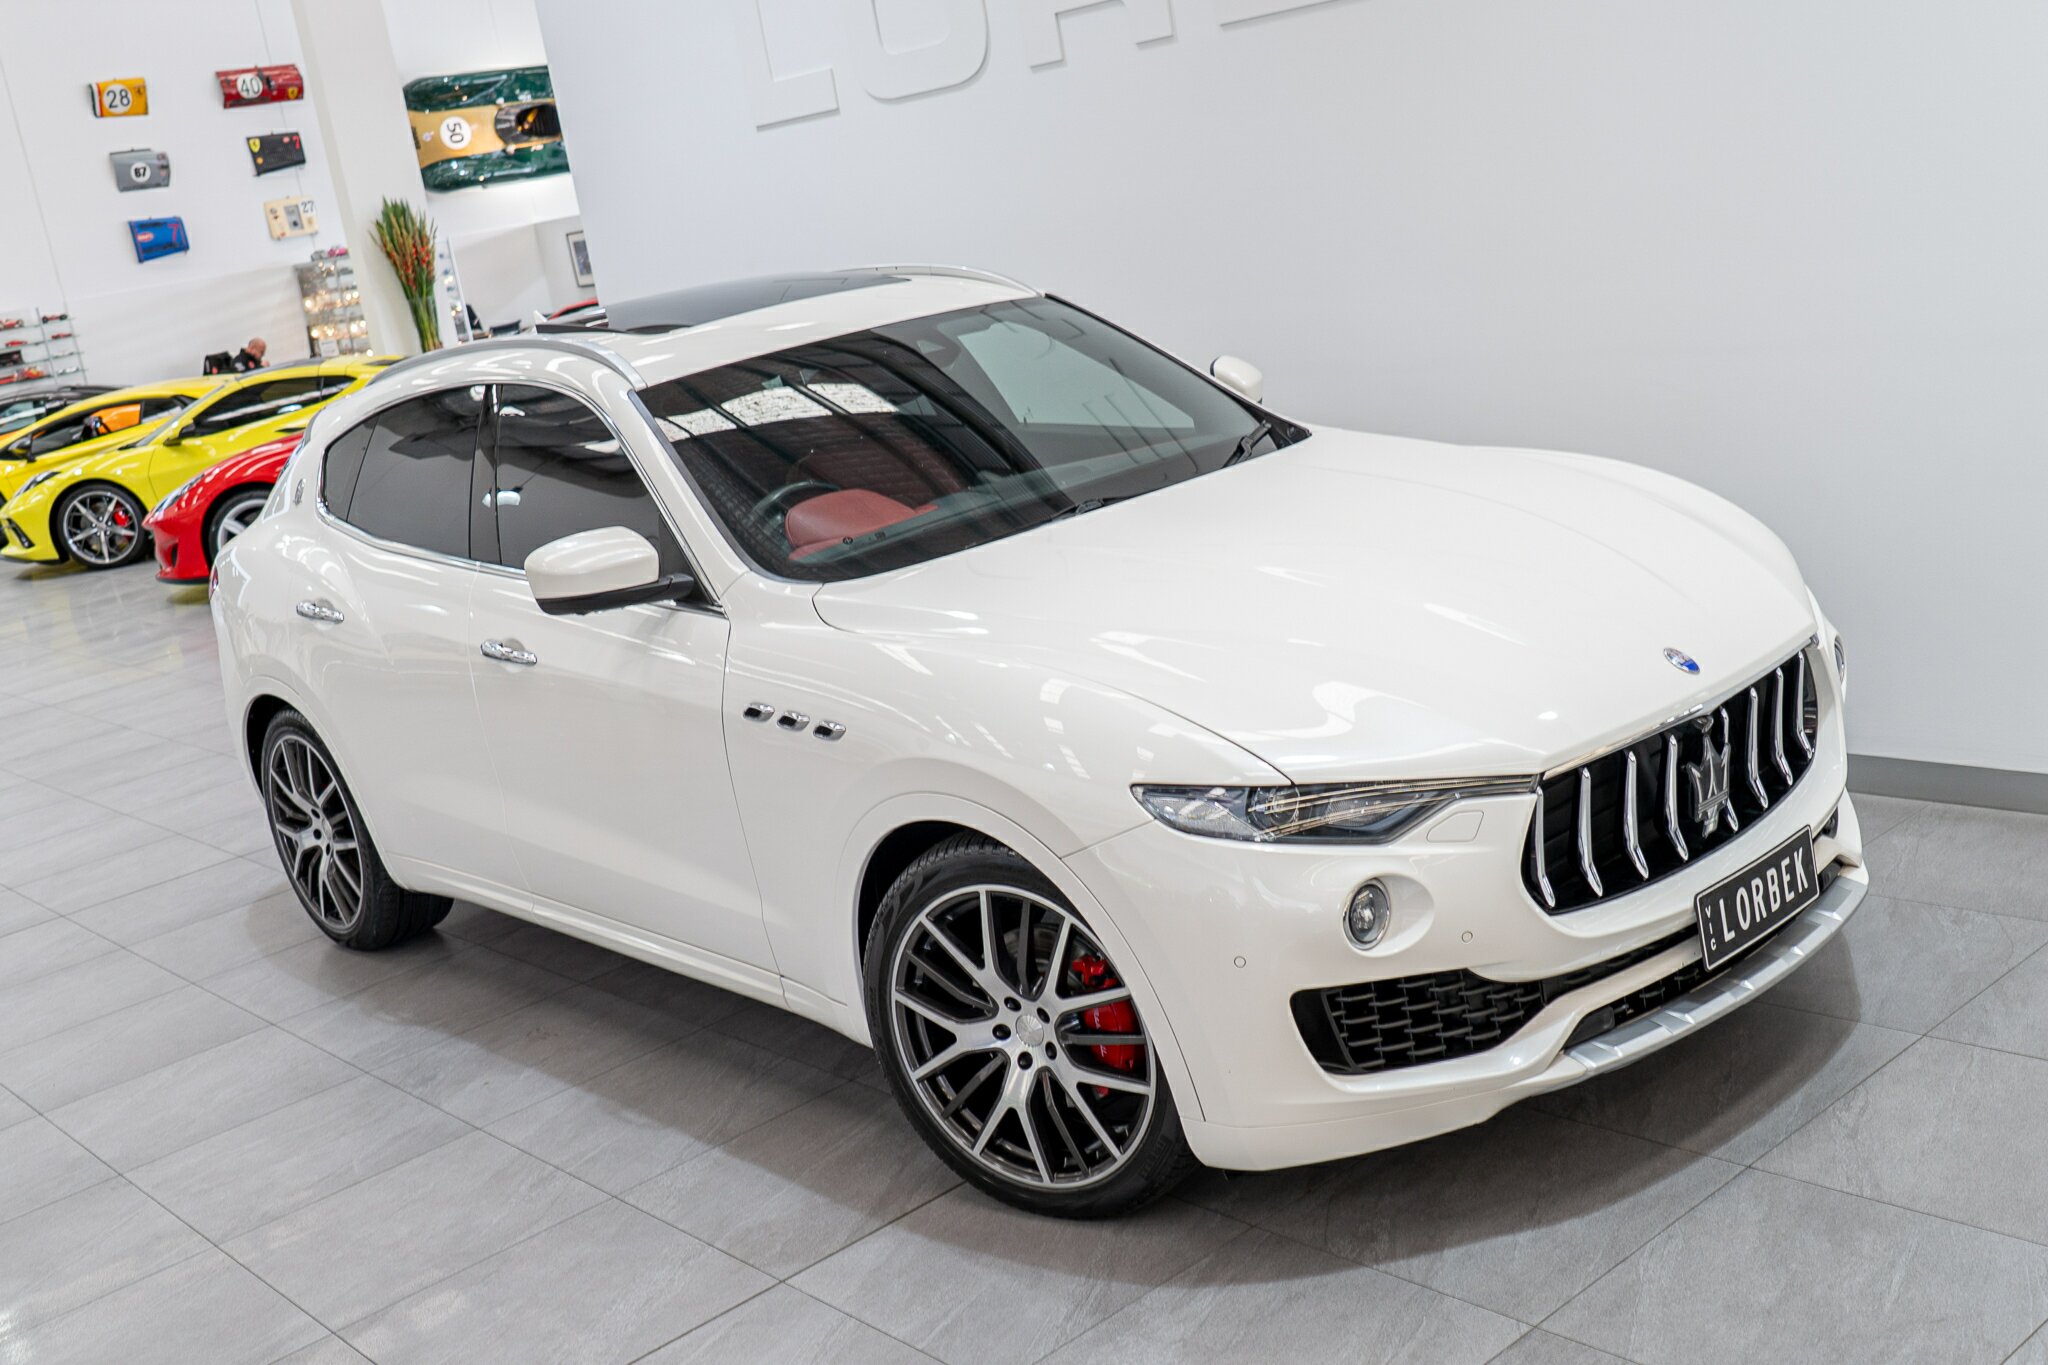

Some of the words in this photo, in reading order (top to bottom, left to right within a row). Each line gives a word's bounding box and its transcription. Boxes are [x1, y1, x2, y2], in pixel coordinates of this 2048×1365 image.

[241, 77, 260, 96] 40
[106, 88, 130, 109] 28
[446, 122, 464, 143] 50
[300, 200, 314, 213] 27
[168, 223, 179, 243] 7
[1719, 847, 1809, 943] LORBEK
[1705, 905, 1717, 951] VIC
